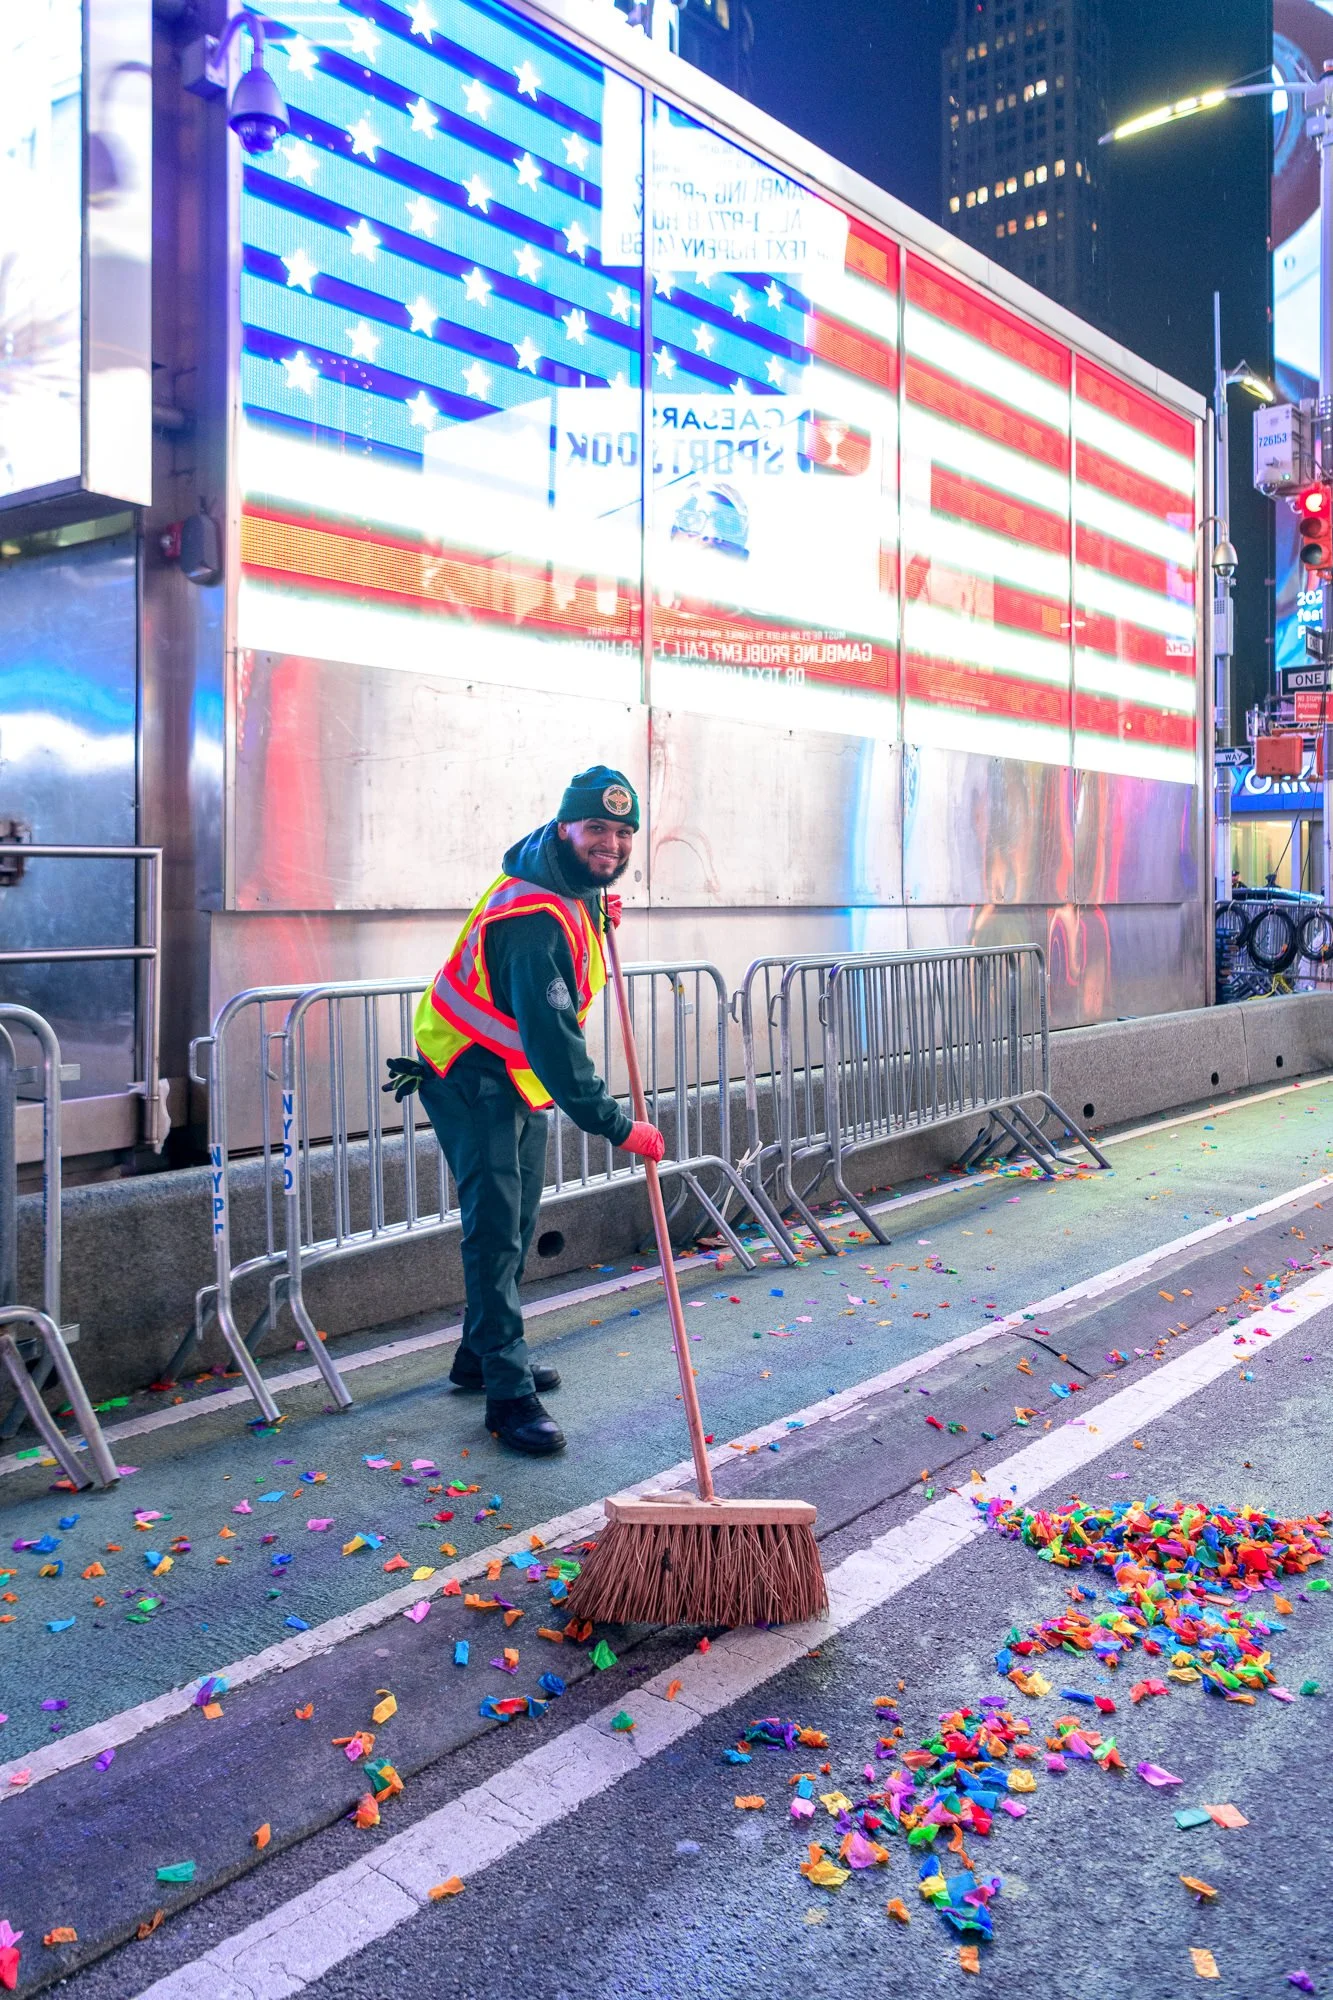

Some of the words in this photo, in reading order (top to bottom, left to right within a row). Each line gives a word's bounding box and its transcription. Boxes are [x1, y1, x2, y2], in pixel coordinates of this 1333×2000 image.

[1259, 432, 1288, 447] 726153
[1296, 590, 1323, 606] 202
[1295, 673, 1322, 686] ONE
[1225, 753, 1243, 761] WAY
